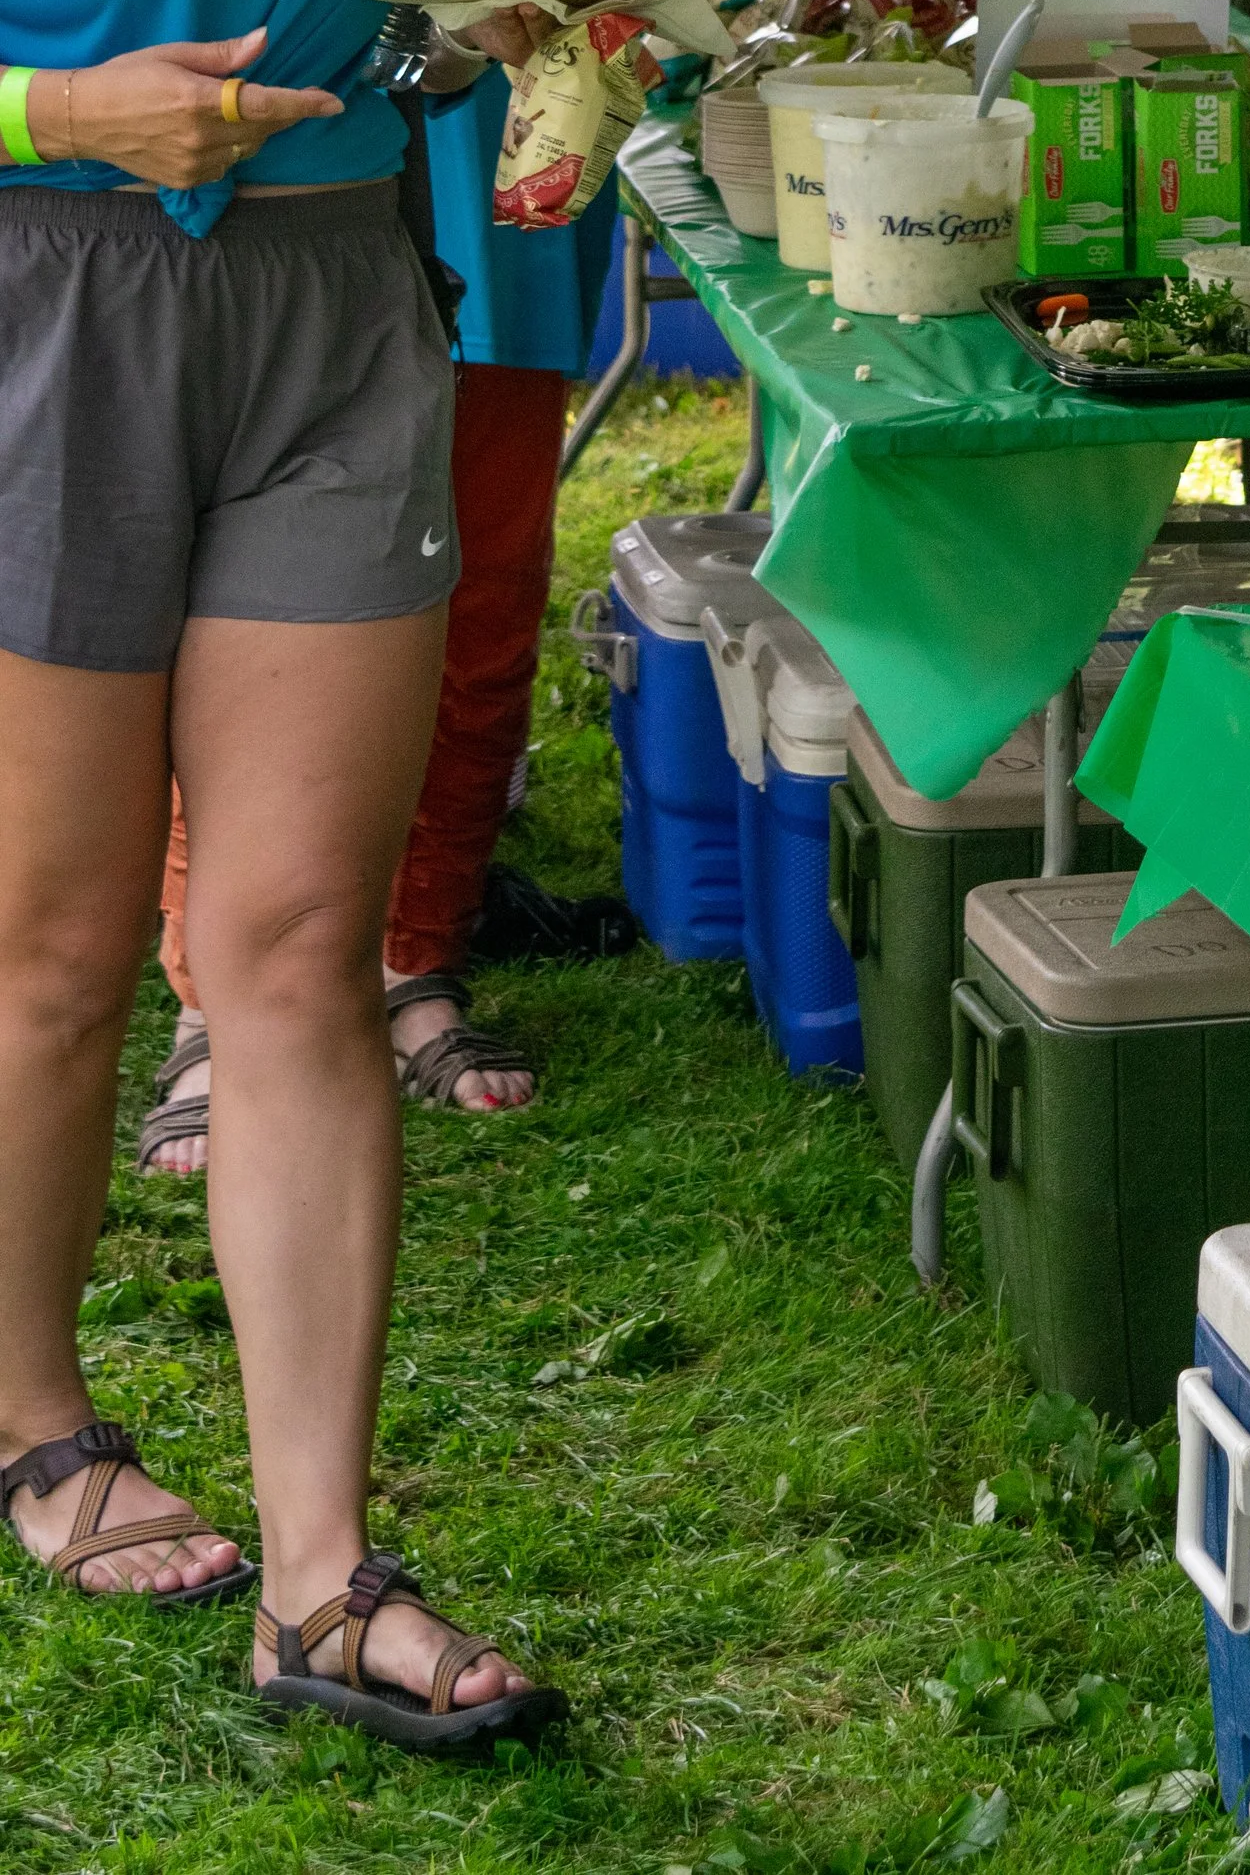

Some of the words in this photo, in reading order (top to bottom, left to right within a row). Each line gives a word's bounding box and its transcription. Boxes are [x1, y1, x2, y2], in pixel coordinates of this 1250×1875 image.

[1079, 85, 1102, 161] FORKS
[1195, 95, 1219, 174] FORKS
[786, 173, 826, 197] Mrs.
[879, 215, 934, 238] Mrs.
[937, 207, 1015, 246] Gerry's
